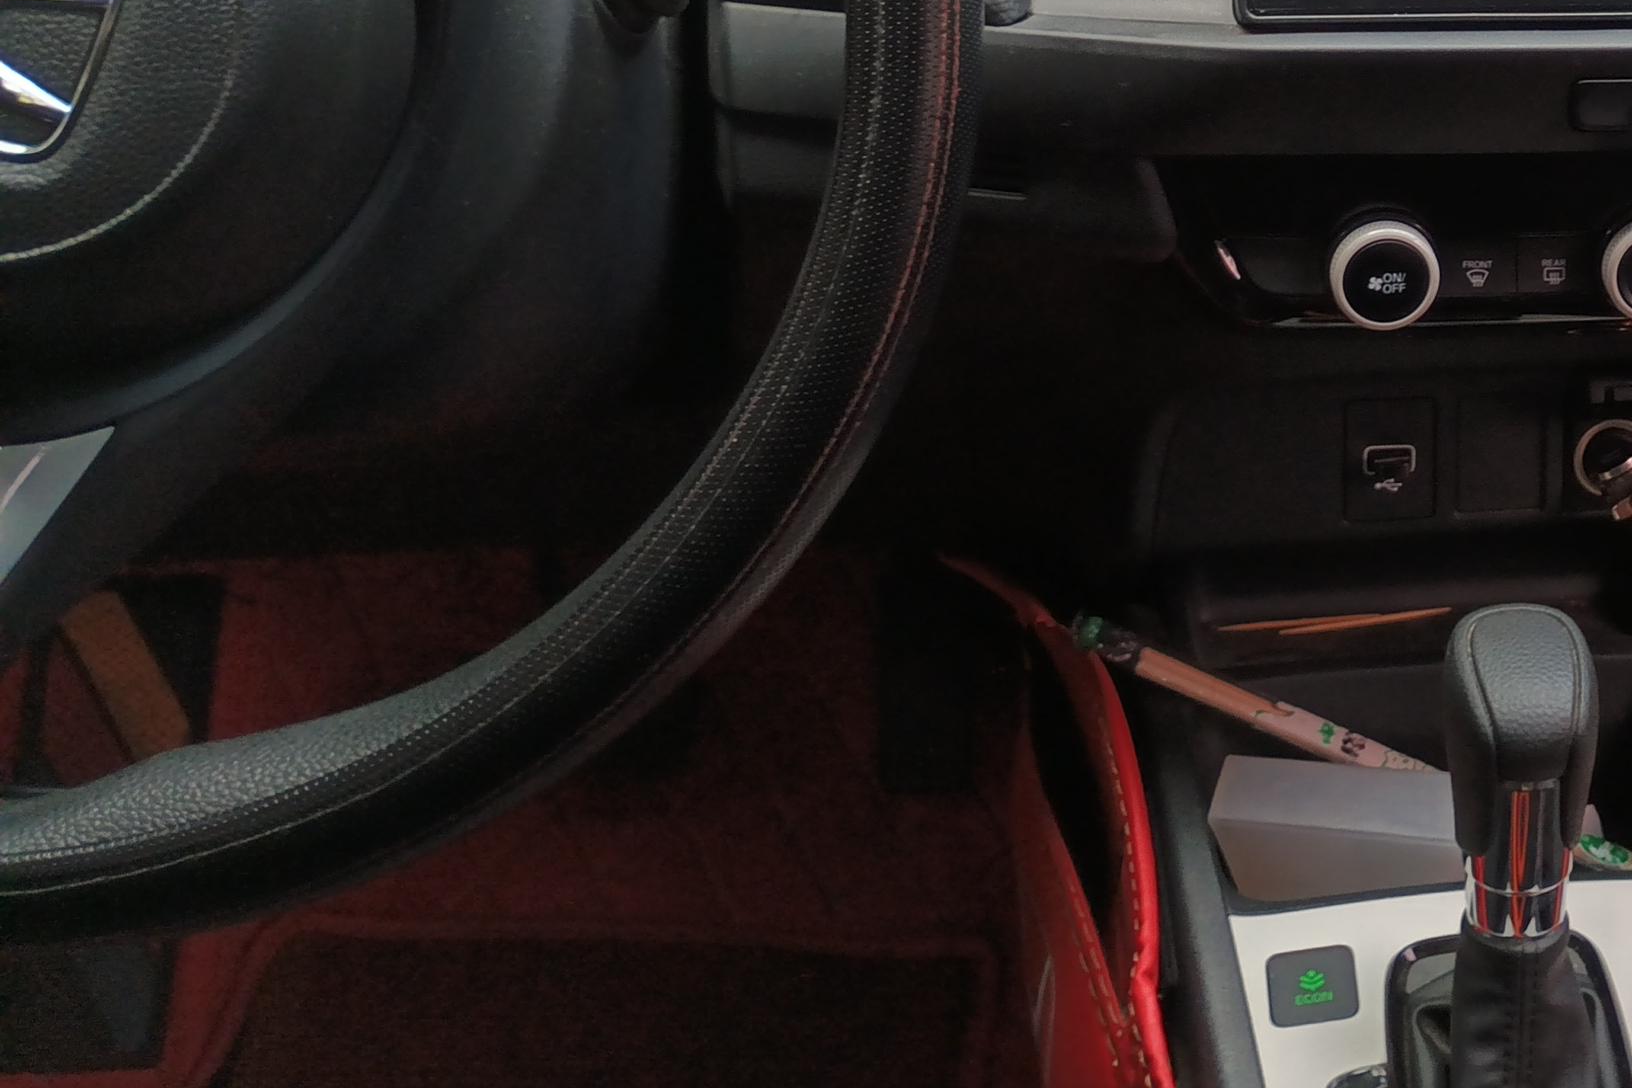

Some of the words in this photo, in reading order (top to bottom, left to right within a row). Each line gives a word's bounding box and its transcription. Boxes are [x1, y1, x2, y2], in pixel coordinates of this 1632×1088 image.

[1462, 259, 1493, 269] FRONT
[1382, 272, 1407, 283] ON/
[1382, 283, 1407, 294] OFF
